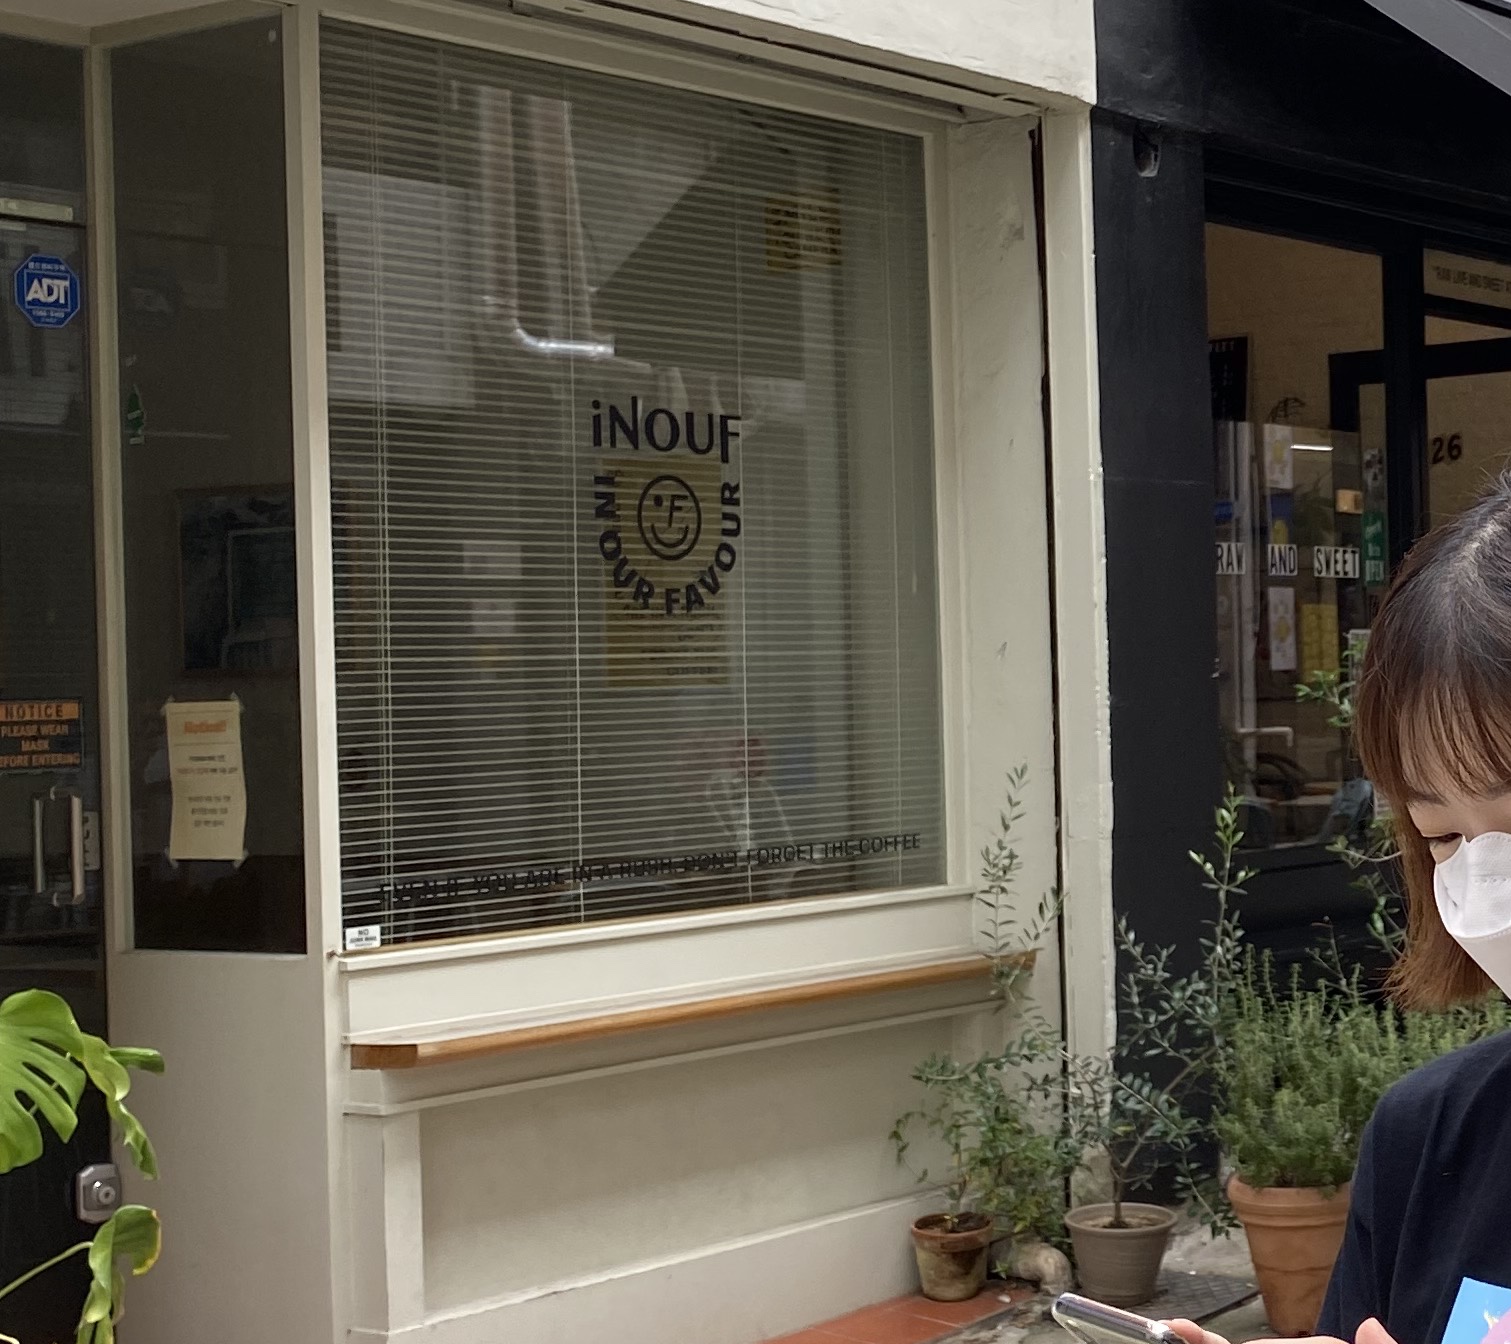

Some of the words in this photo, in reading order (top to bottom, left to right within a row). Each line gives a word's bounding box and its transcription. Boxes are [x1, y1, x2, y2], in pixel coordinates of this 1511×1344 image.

[25, 277, 70, 305] ADT
[592, 395, 742, 464] iNOUF
[1430, 432, 1462, 466] 26
[593, 475, 616, 520] IN
[664, 481, 742, 617] FAVOUR
[1216, 544, 1245, 574] RAW
[1270, 544, 1297, 575] AND
[1315, 547, 1359, 577] SWEET
[599, 529, 656, 611] OUR
[5, 704, 64, 719] NOTICE
[748, 844, 814, 866] FORGET
[824, 840, 858, 859] THE
[859, 833, 921, 856] COFFEE
